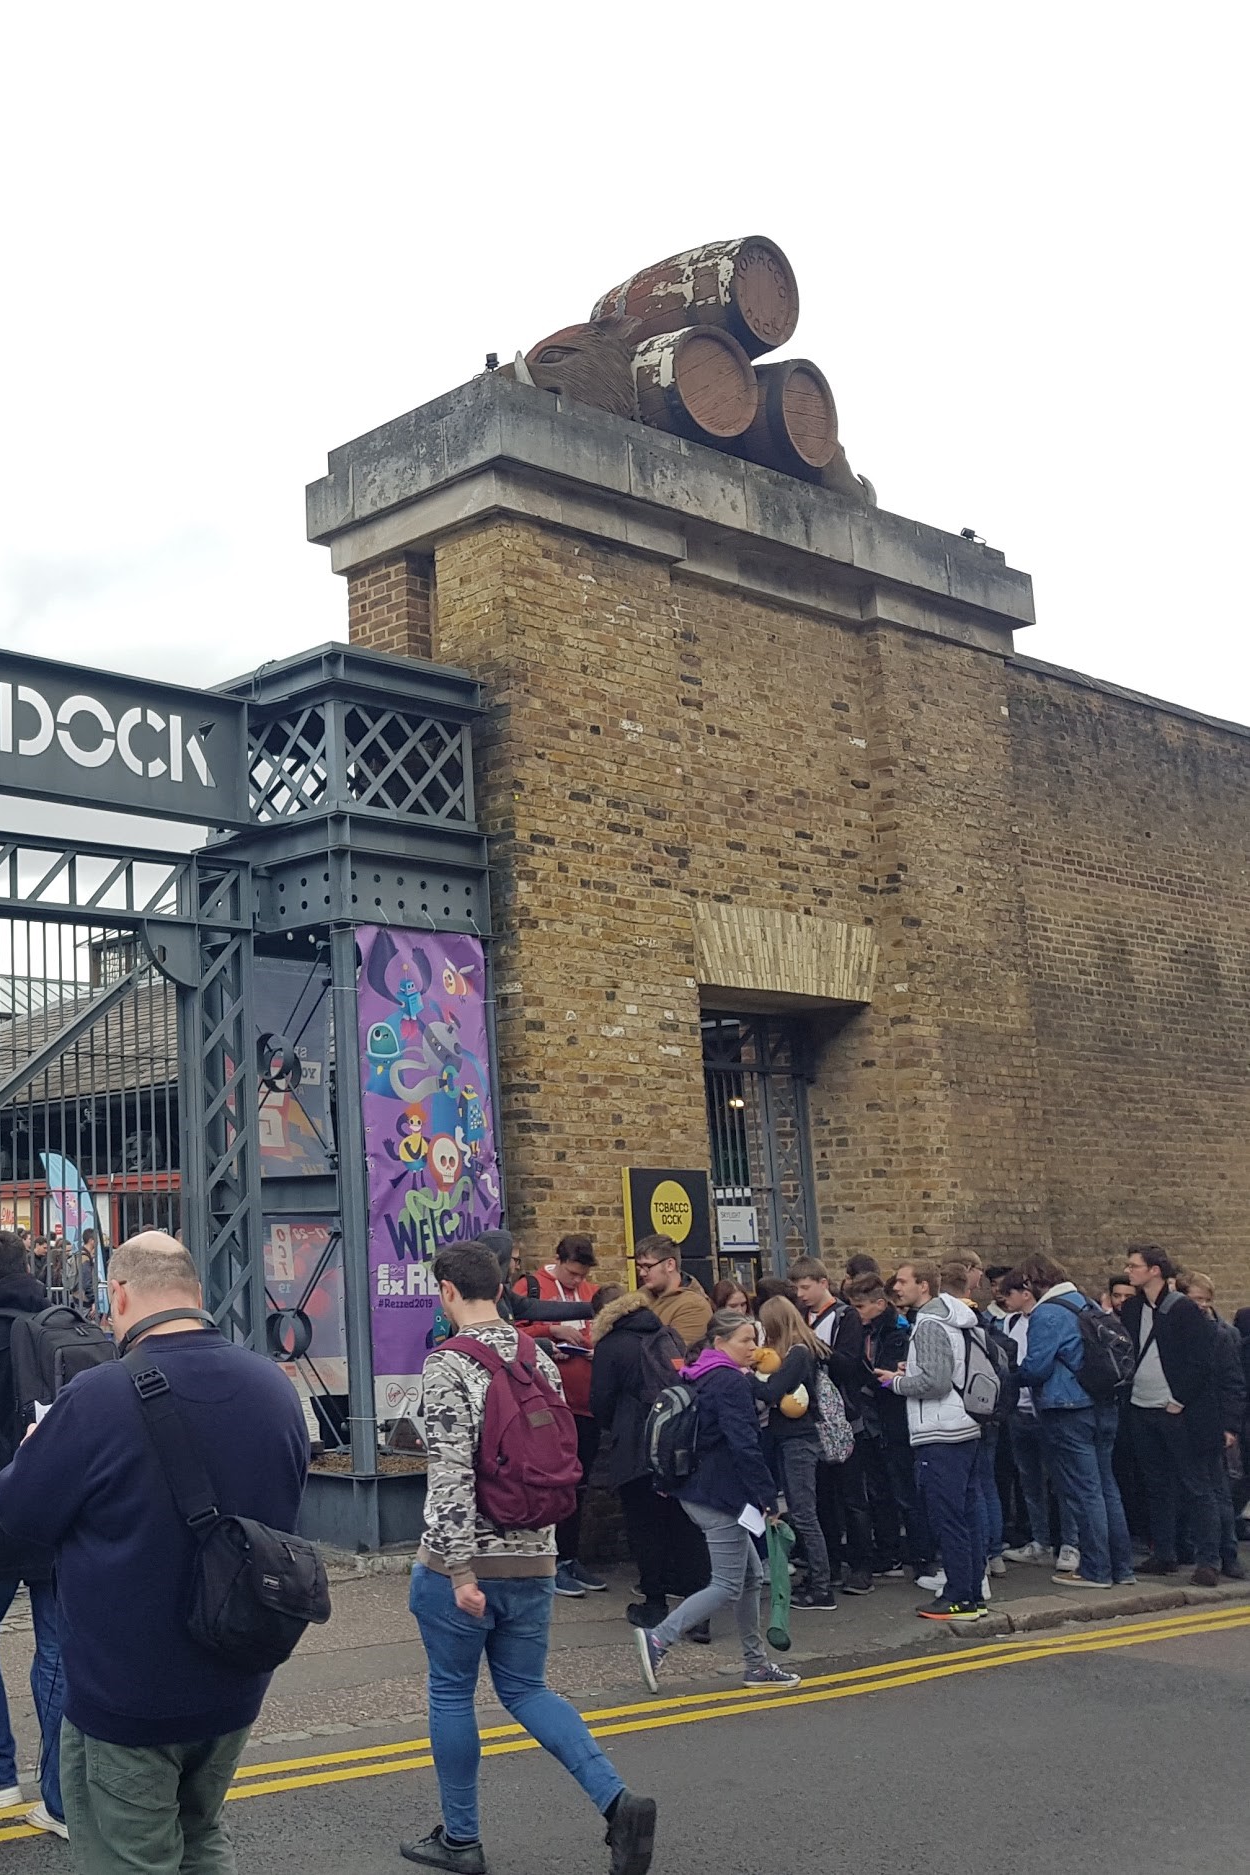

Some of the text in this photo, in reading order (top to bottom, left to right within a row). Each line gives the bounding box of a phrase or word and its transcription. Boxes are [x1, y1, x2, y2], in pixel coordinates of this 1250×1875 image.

[654, 1202, 689, 1213] TOBACCO
[662, 1214, 683, 1225] DOCK
[378, 1298, 433, 1309] #Rezzed2019
